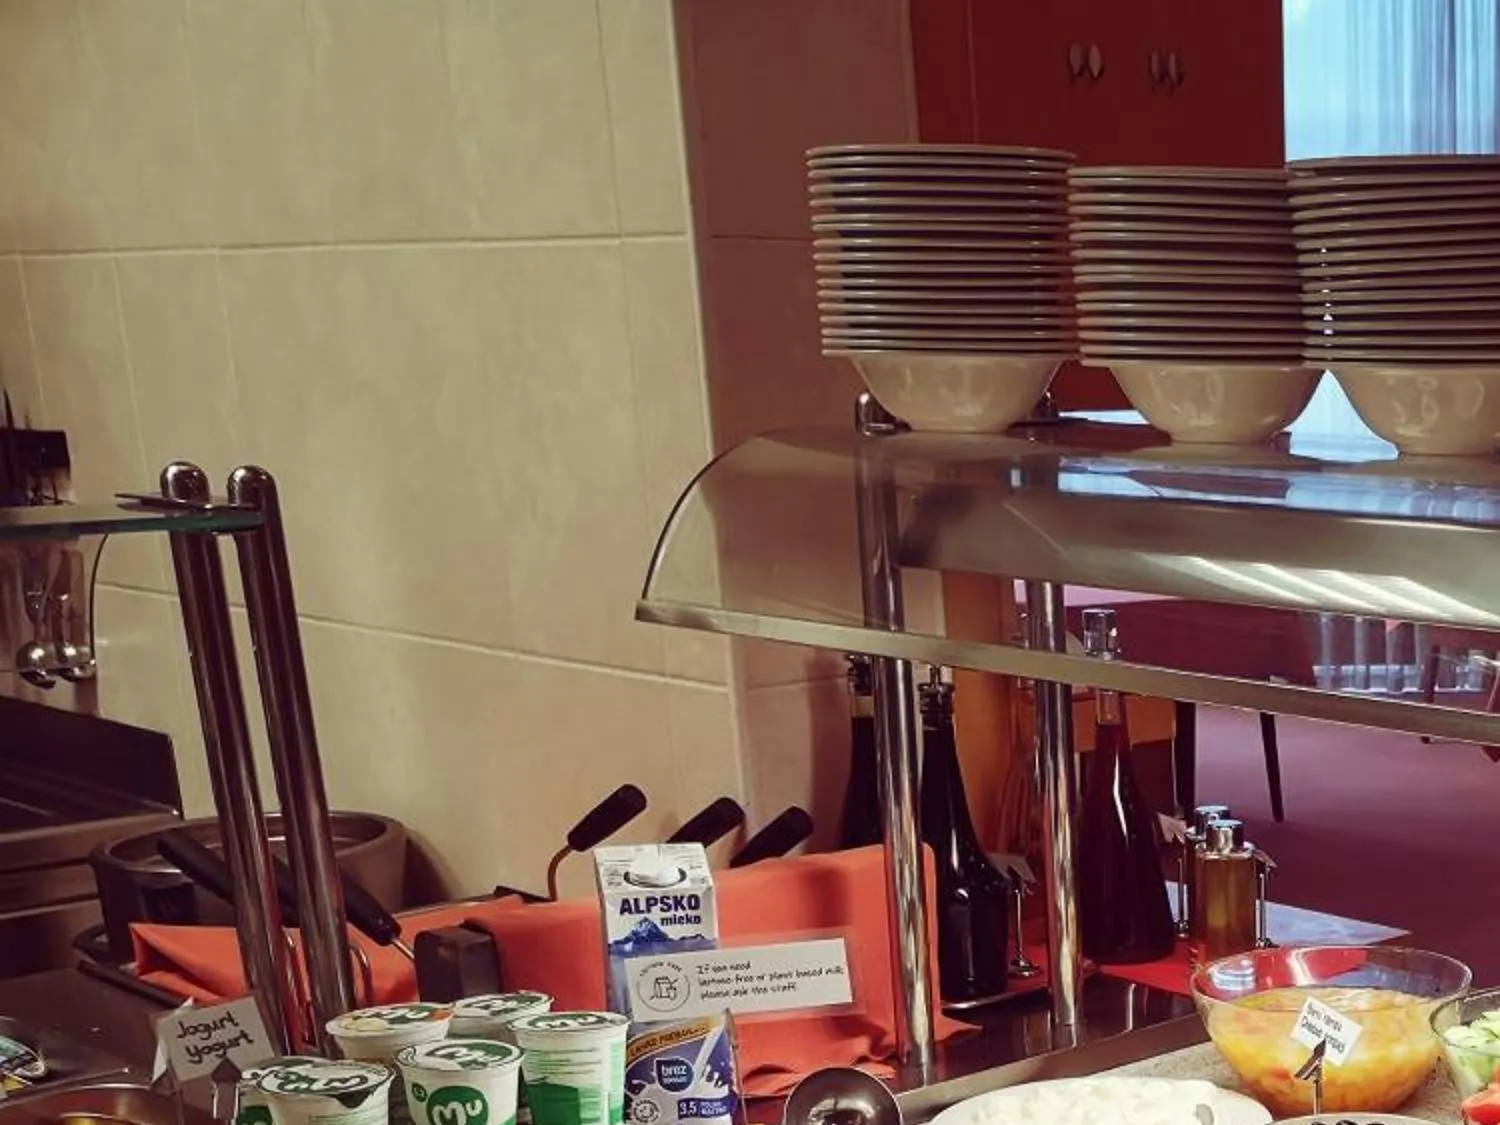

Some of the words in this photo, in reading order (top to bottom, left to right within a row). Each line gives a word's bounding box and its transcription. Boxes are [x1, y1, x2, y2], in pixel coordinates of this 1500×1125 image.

[619, 894, 701, 915] ALPSKO
[661, 914, 702, 926] mleko
[177, 1009, 239, 1041] Jogurt
